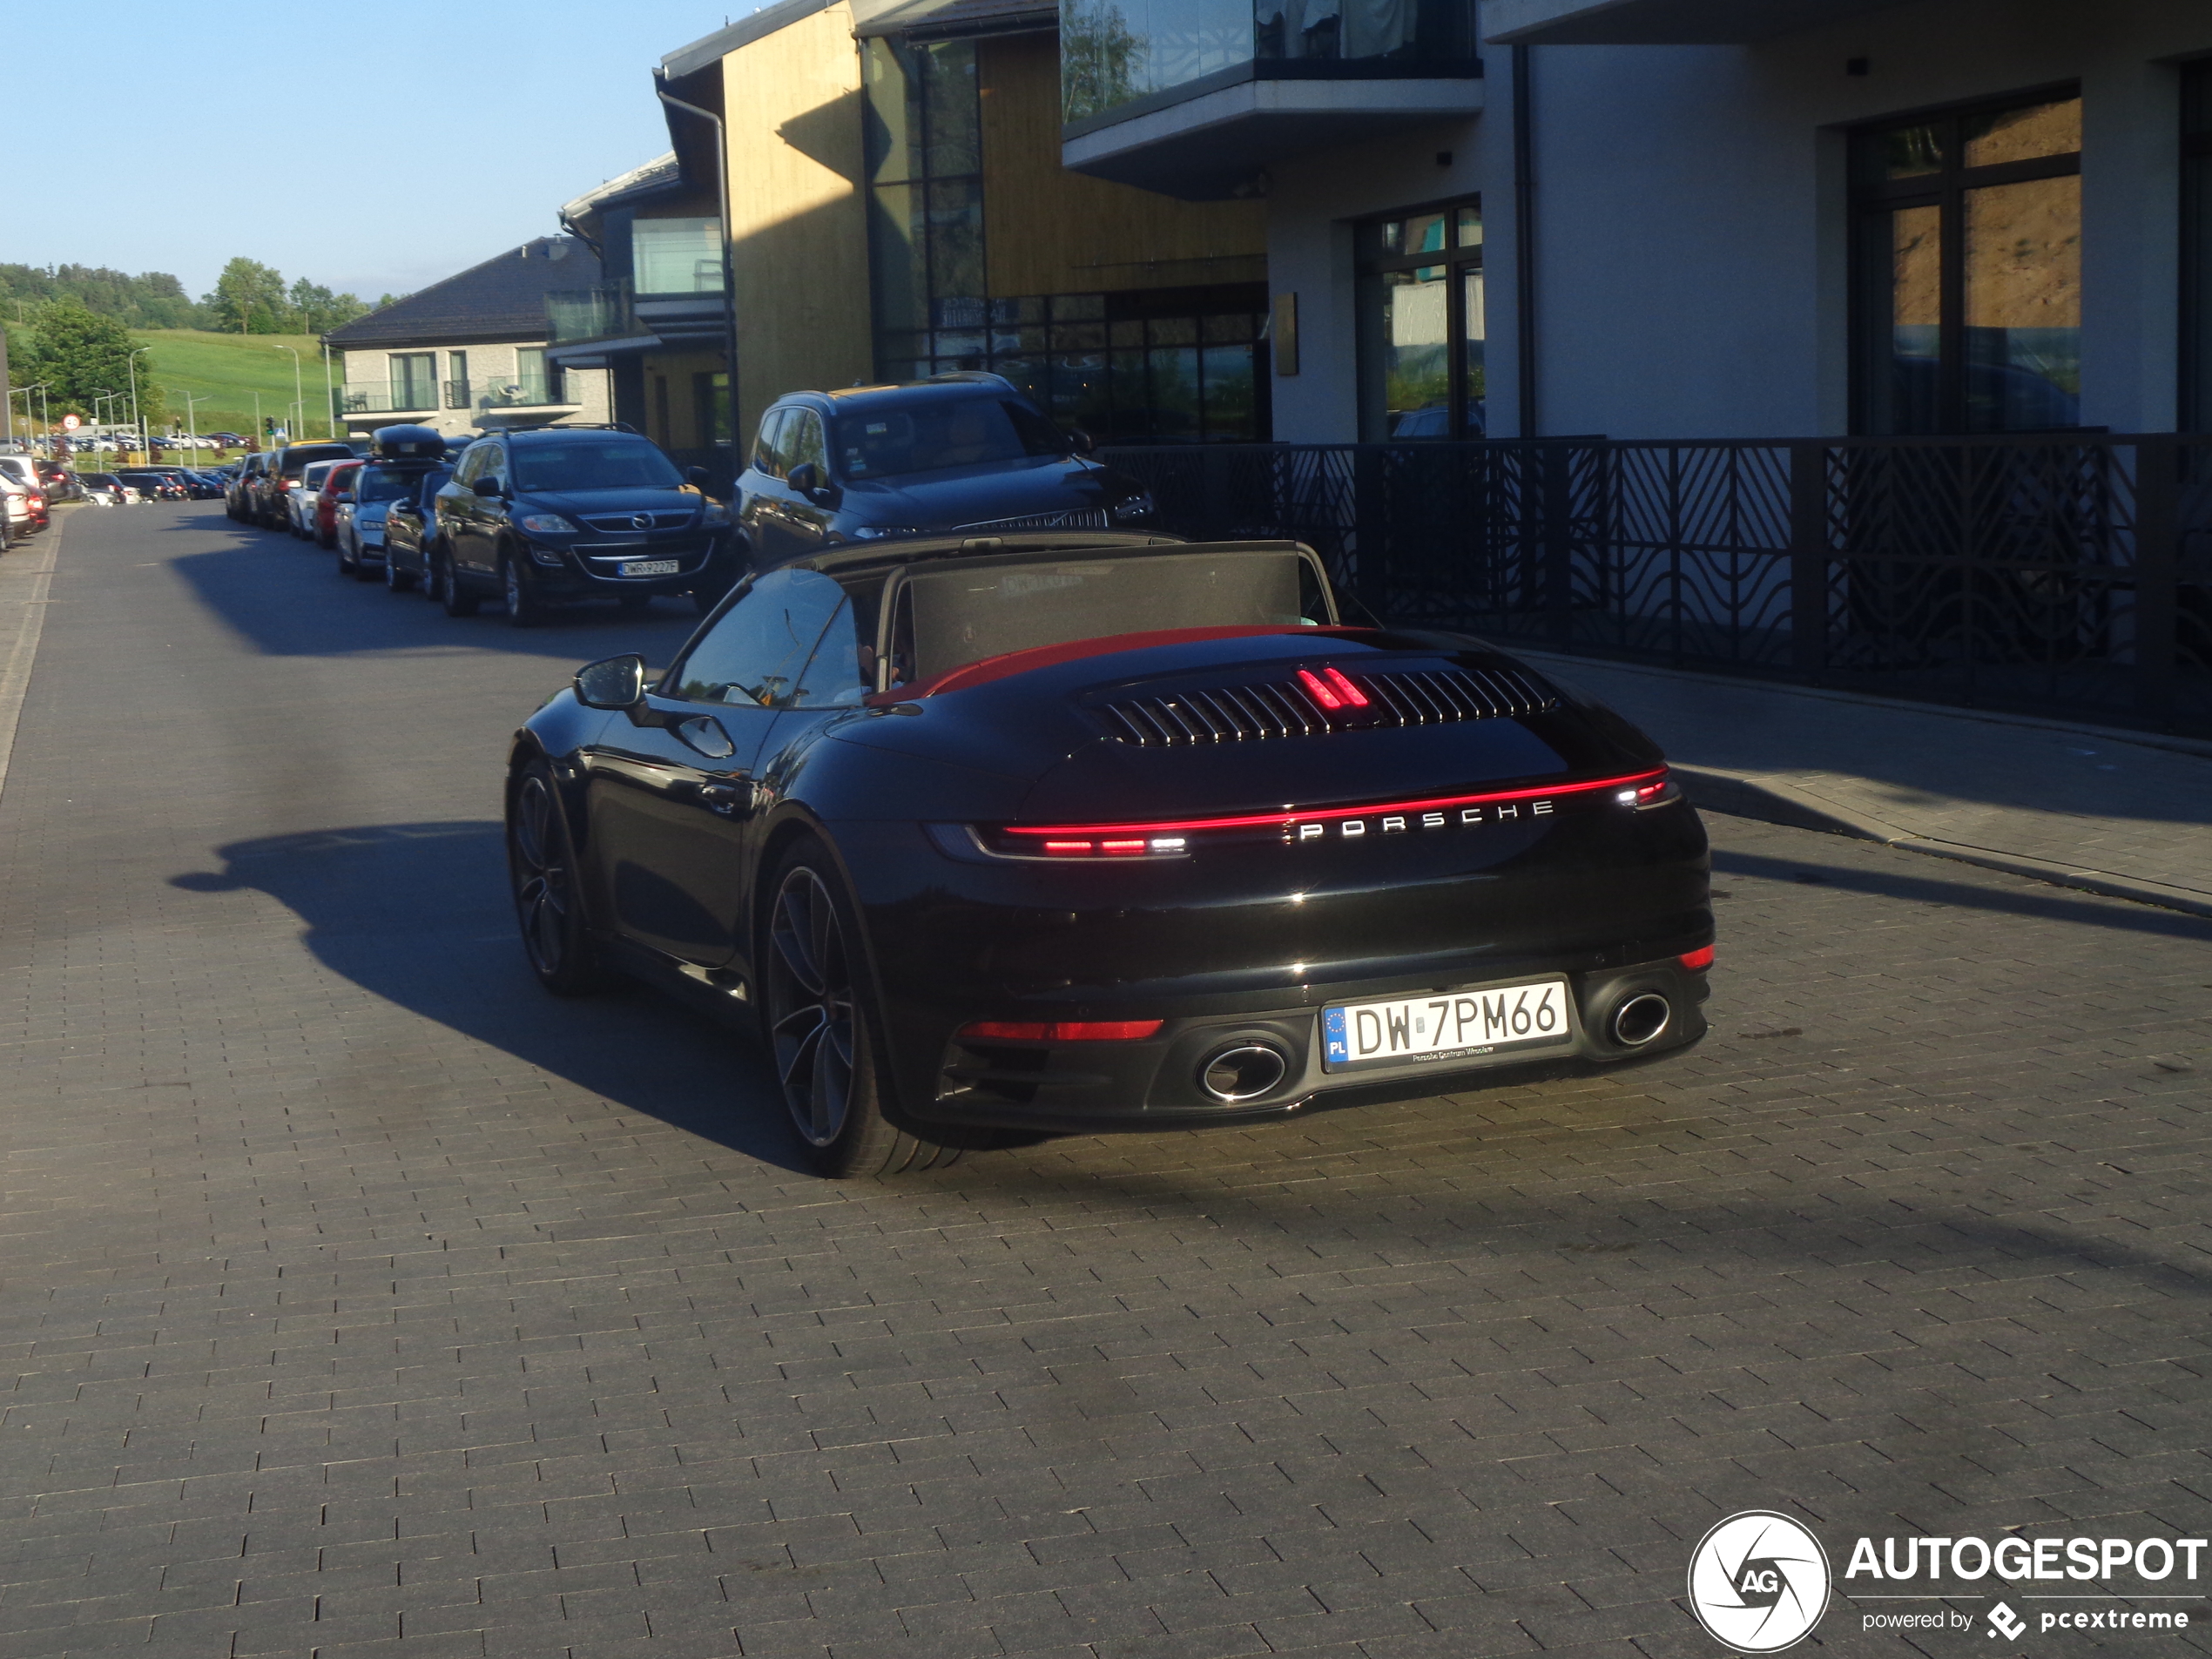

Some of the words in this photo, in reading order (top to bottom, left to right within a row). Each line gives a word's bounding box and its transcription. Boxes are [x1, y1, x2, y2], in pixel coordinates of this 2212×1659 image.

[624, 563, 644, 574] DWR
[1300, 800, 1554, 840] PORSCHE
[1356, 1005, 1410, 1055] DW
[1428, 988, 1556, 1047] 7PM66
[1330, 1042, 1345, 1055] PL
[1413, 1052, 1439, 1062] Porsche
[1439, 1049, 1466, 1060] Centrum
